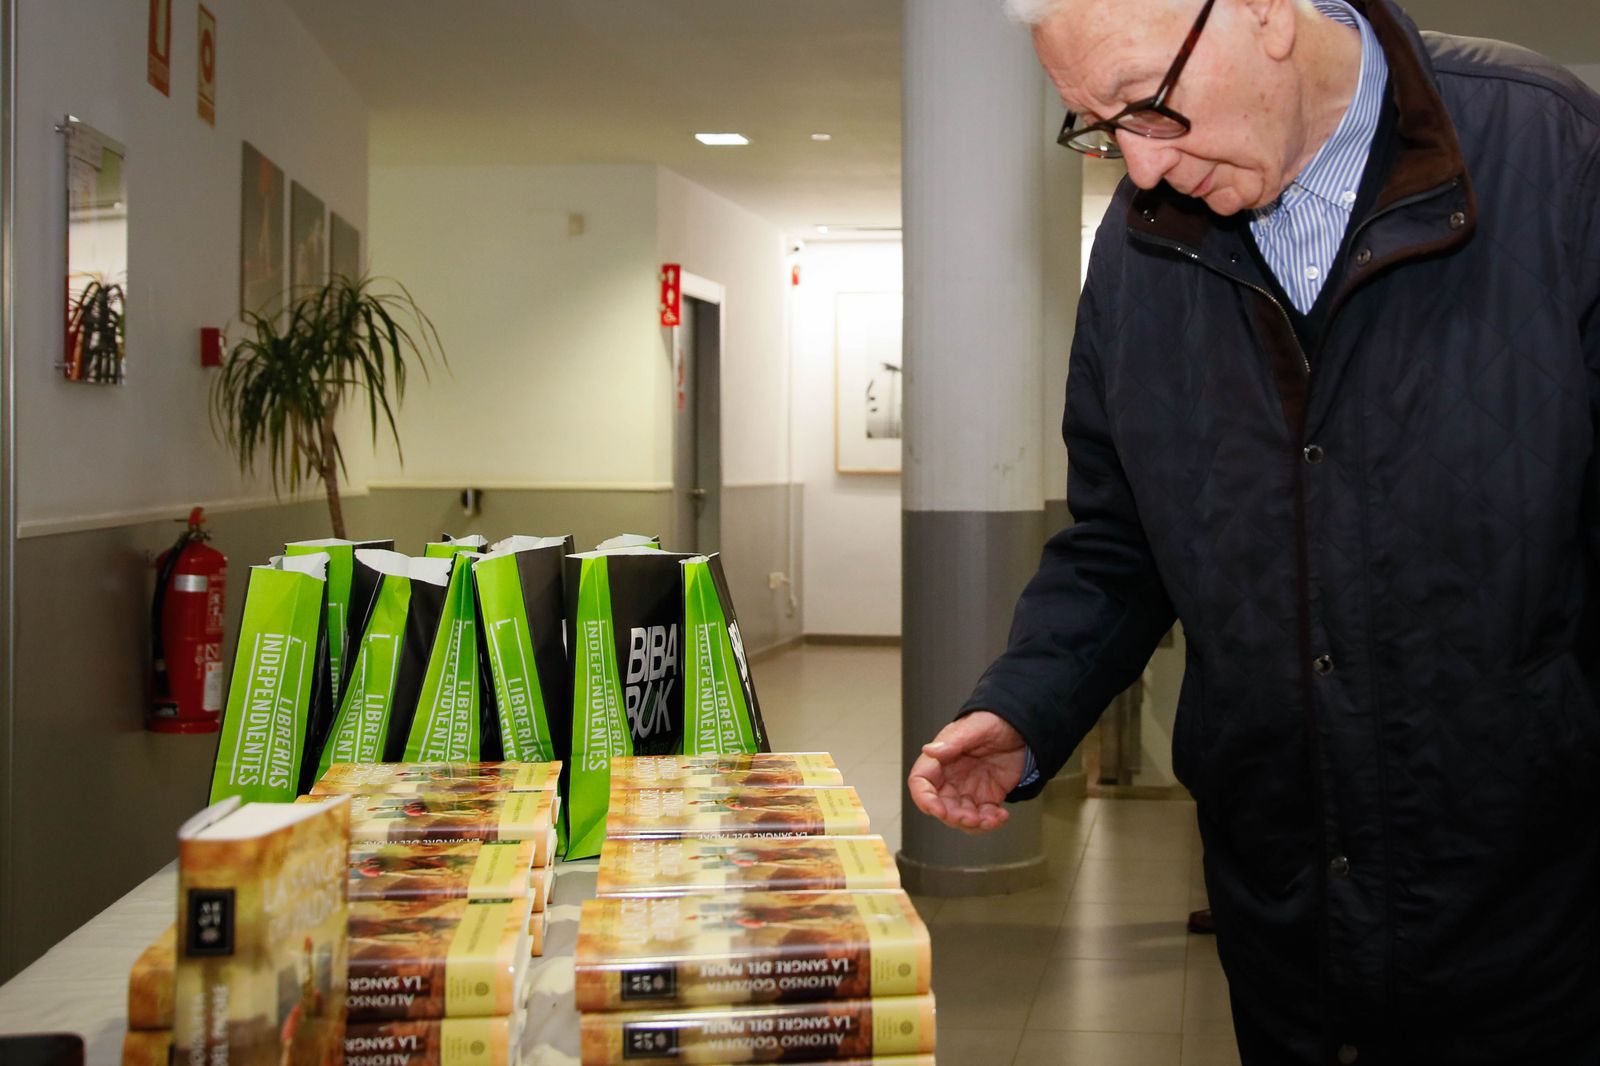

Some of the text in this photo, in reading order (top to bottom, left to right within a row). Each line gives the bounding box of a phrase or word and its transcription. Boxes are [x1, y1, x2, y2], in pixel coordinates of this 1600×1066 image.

[626, 623, 678, 685] BIBA
[238, 633, 285, 786] INDEPENDIENTES
[426, 619, 462, 762] INDEPENDIENTE
[450, 680, 471, 761] LIBRERÍA
[587, 620, 608, 771] INDEPENDIENTES
[605, 679, 623, 757] LIBRERÍA
[625, 678, 675, 741] BUK
[698, 623, 717, 755] INDEPENDIENT
[715, 680, 742, 755] LIBRERÍA
[268, 697, 293, 789] LIBRERÍAS
[360, 694, 385, 762] LIBRERÍ
[348, 975, 422, 991] LA SANGR
[698, 957, 850, 978] LA SANGRE DEL PADRE
[706, 974, 843, 992] ALFONSO GOIZUETA
[346, 993, 414, 1008] ALFONSO
[701, 1014, 851, 1035] LA SANGRE DEL PADRE
[344, 1034, 417, 1052] LA SANGR
[707, 1032, 844, 1051] ALFONSO GOIZUETA
